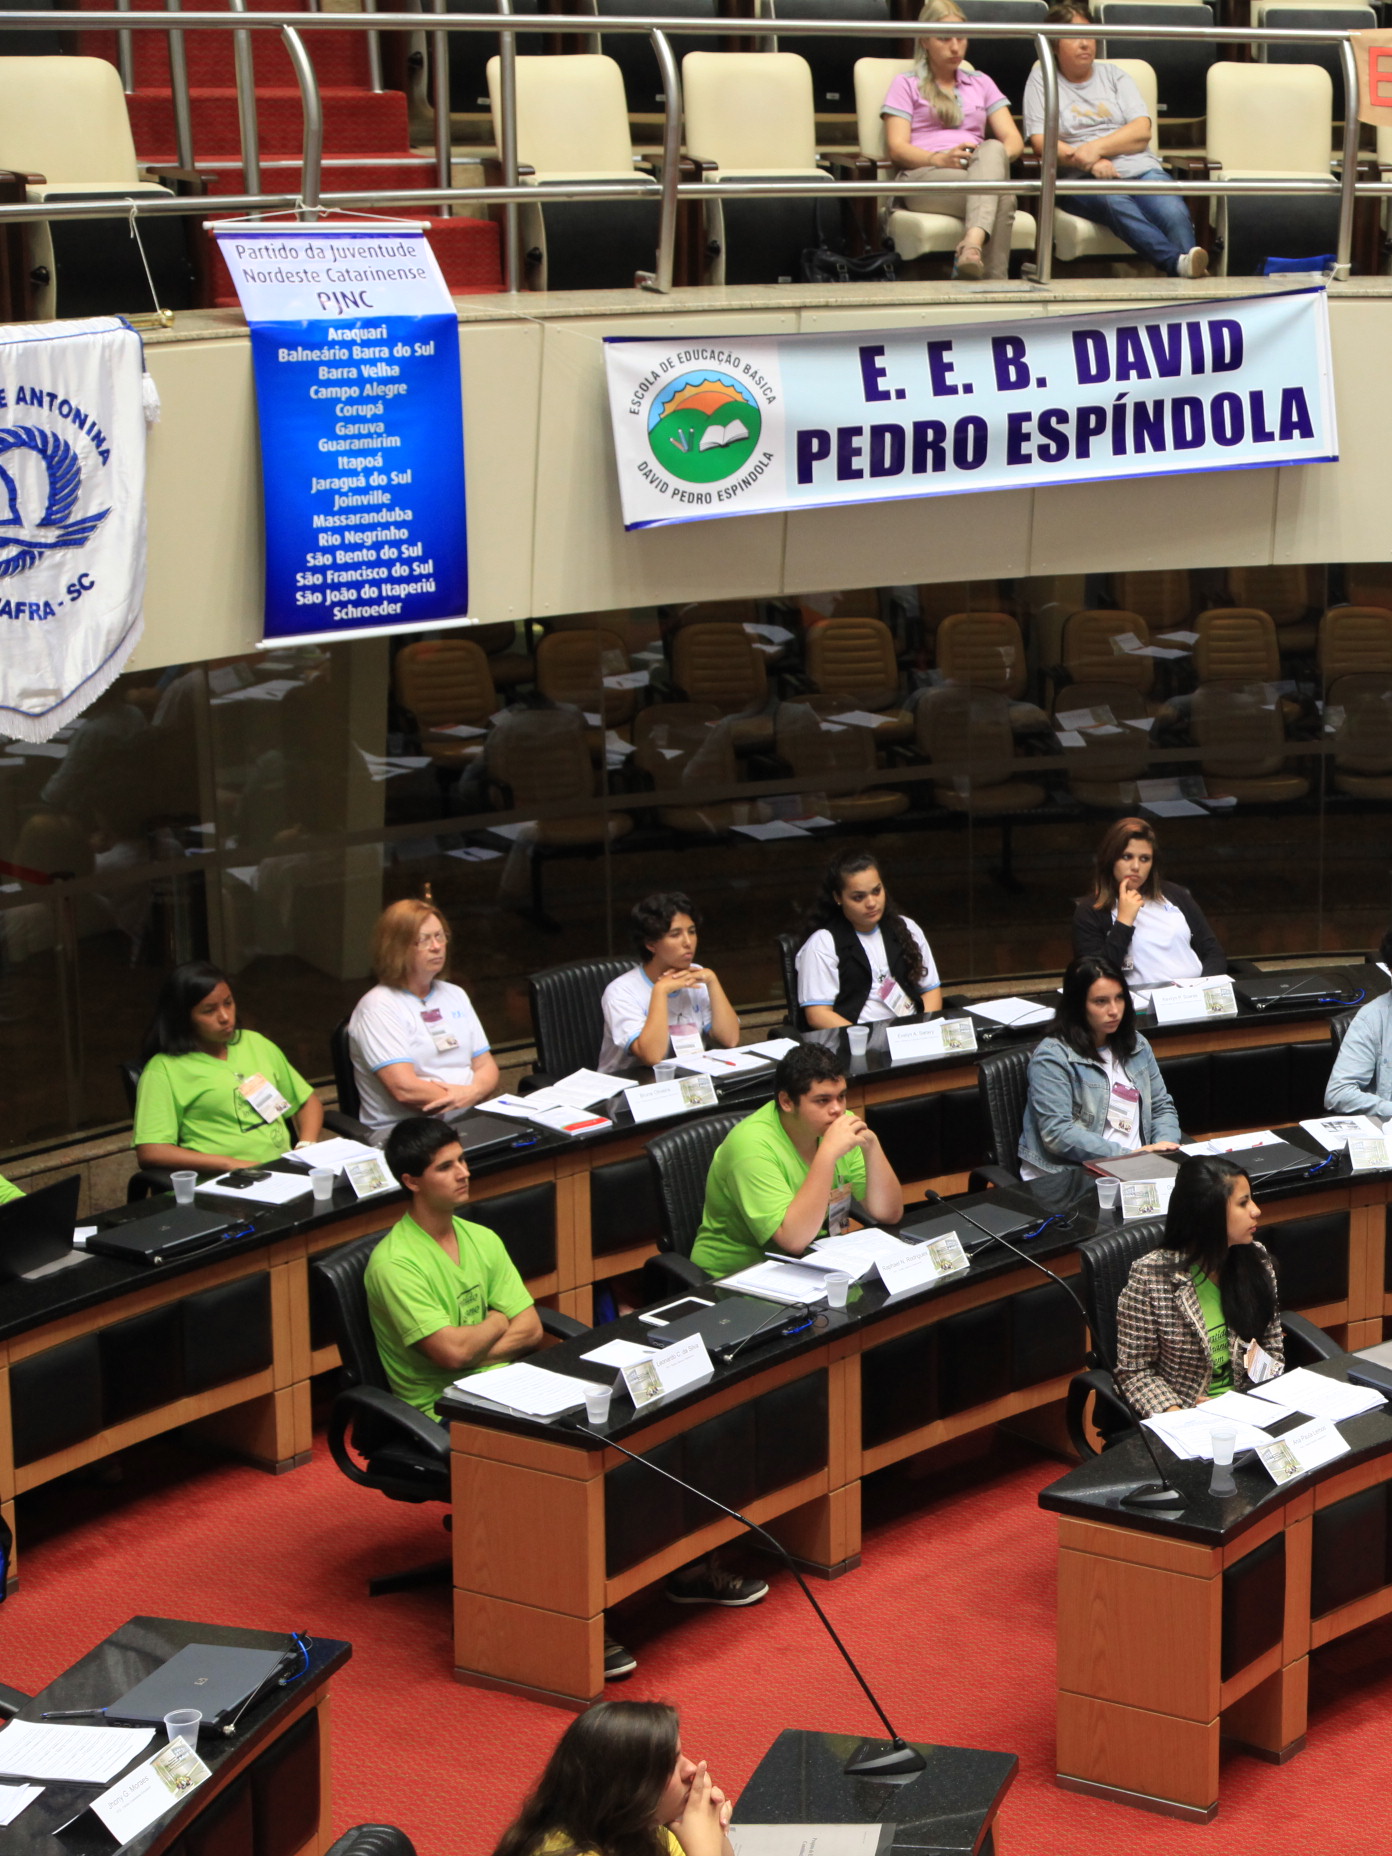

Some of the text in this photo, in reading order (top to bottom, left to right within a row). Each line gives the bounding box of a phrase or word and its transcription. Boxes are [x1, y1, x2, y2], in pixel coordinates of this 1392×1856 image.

[235, 242, 418, 263] Partido da Juventude
[242, 265, 428, 284] Nordeste Catarinense
[316, 290, 375, 316] PJNC
[327, 323, 388, 343] Araquari
[277, 341, 435, 363] Balneário Barra do Sul
[858, 318, 1245, 404] E. E. B. DAVID
[318, 362, 401, 381] Barra Velha
[629, 348, 777, 416] ESCOLA DE EDUCAÇÃO BÁSICA
[309, 382, 408, 402] Campo Alegre
[335, 400, 385, 418] Corupá
[15, 385, 110, 467] ANTONINA
[335, 421, 385, 436] Garuva
[796, 388, 1316, 486] PEDRO ESPÍNDOLA
[318, 434, 401, 453] Guaramirim
[337, 452, 384, 472] Itapoá
[310, 469, 413, 494] Jaraguá do Sul
[637, 451, 774, 505] DAVID PEDRO ESPÍNDOLA
[333, 489, 392, 512] Joinville
[312, 507, 414, 529] Massaranduba
[318, 526, 409, 547] Rio Negrinho
[306, 542, 423, 567] São Bento do Sul
[296, 559, 434, 587] São Francisco do Sul
[0, 572, 95, 621] AFRA SC
[295, 578, 436, 606] São João do Itaperiú
[333, 601, 403, 621] Schroeder
